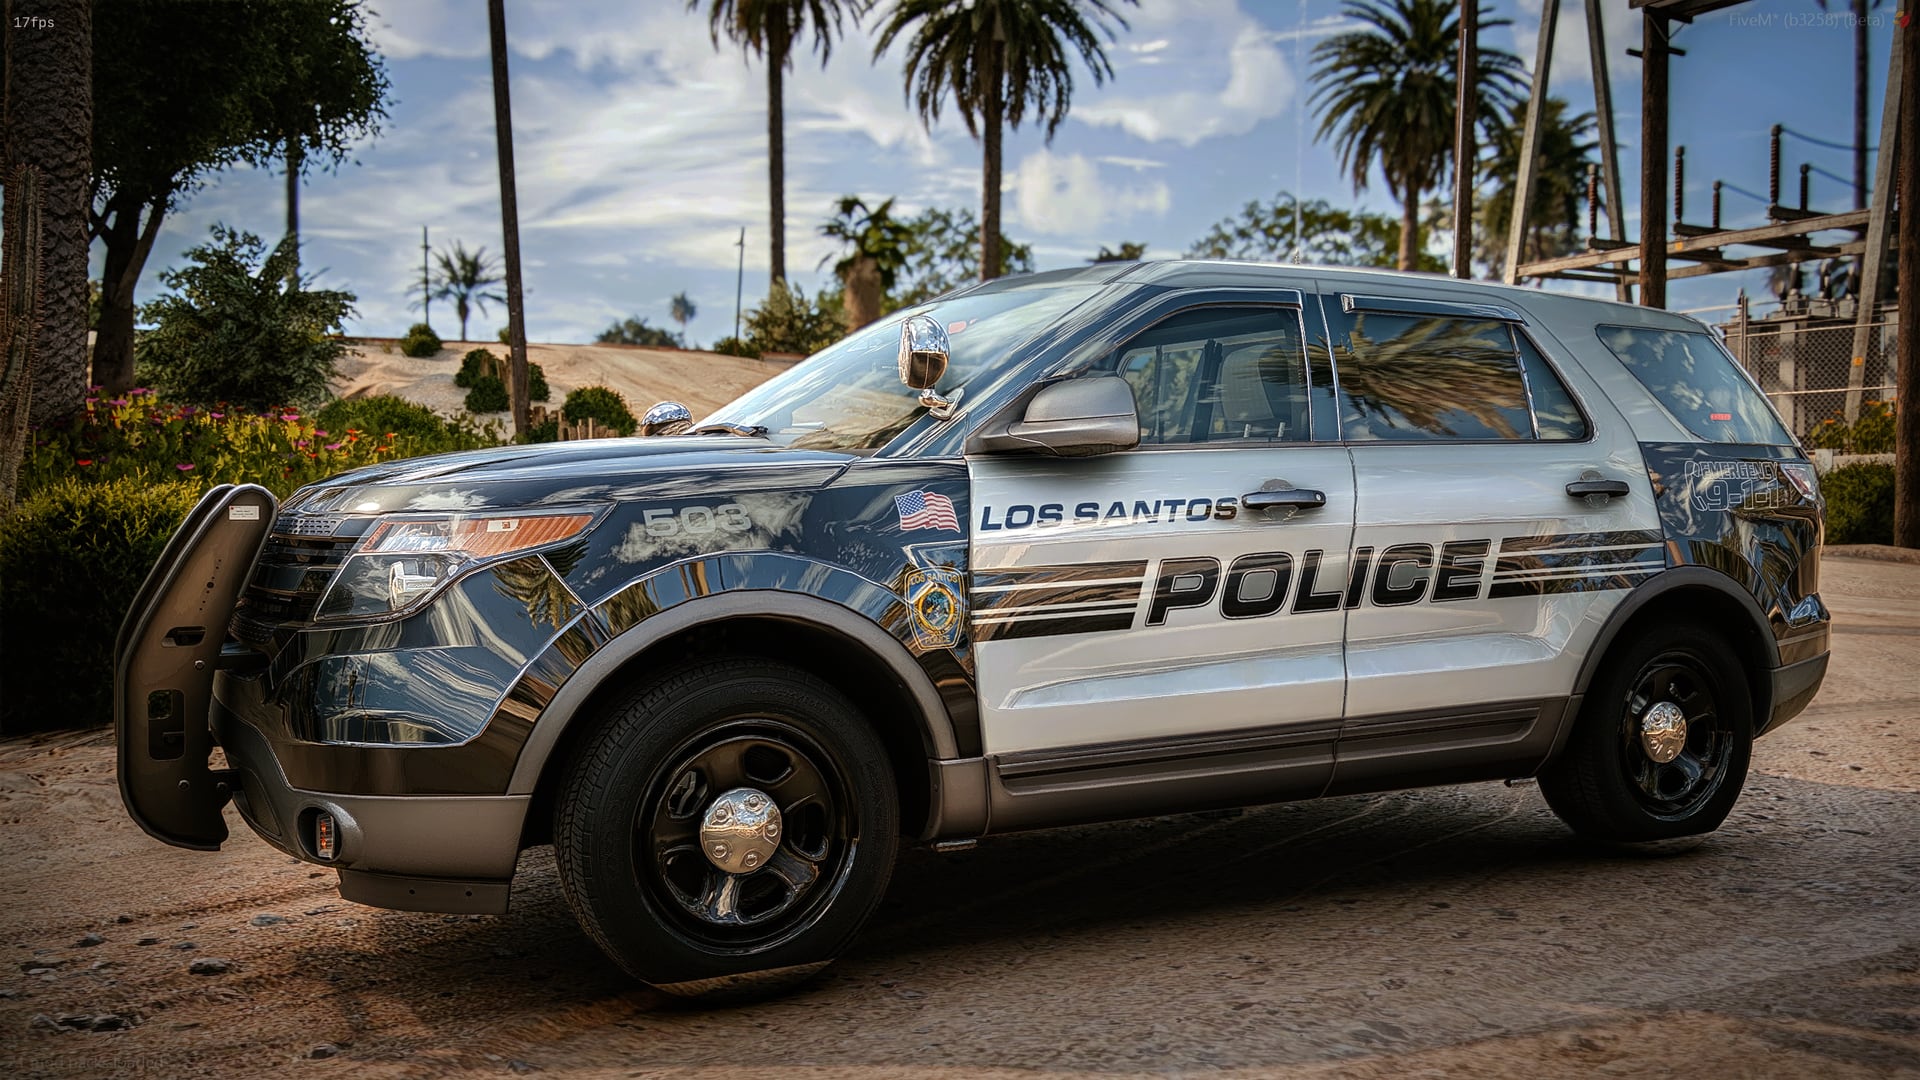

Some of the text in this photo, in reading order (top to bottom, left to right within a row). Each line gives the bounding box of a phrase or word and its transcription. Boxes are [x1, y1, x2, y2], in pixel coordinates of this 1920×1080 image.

[1699, 461, 1779, 480] EMERGENCY
[1705, 479, 1779, 512] 9-1-1
[642, 503, 752, 537] 503
[980, 496, 1239, 531] LOS SANTOS
[911, 572, 958, 585] LOS SANTOS
[1145, 538, 1492, 627] POLICE
